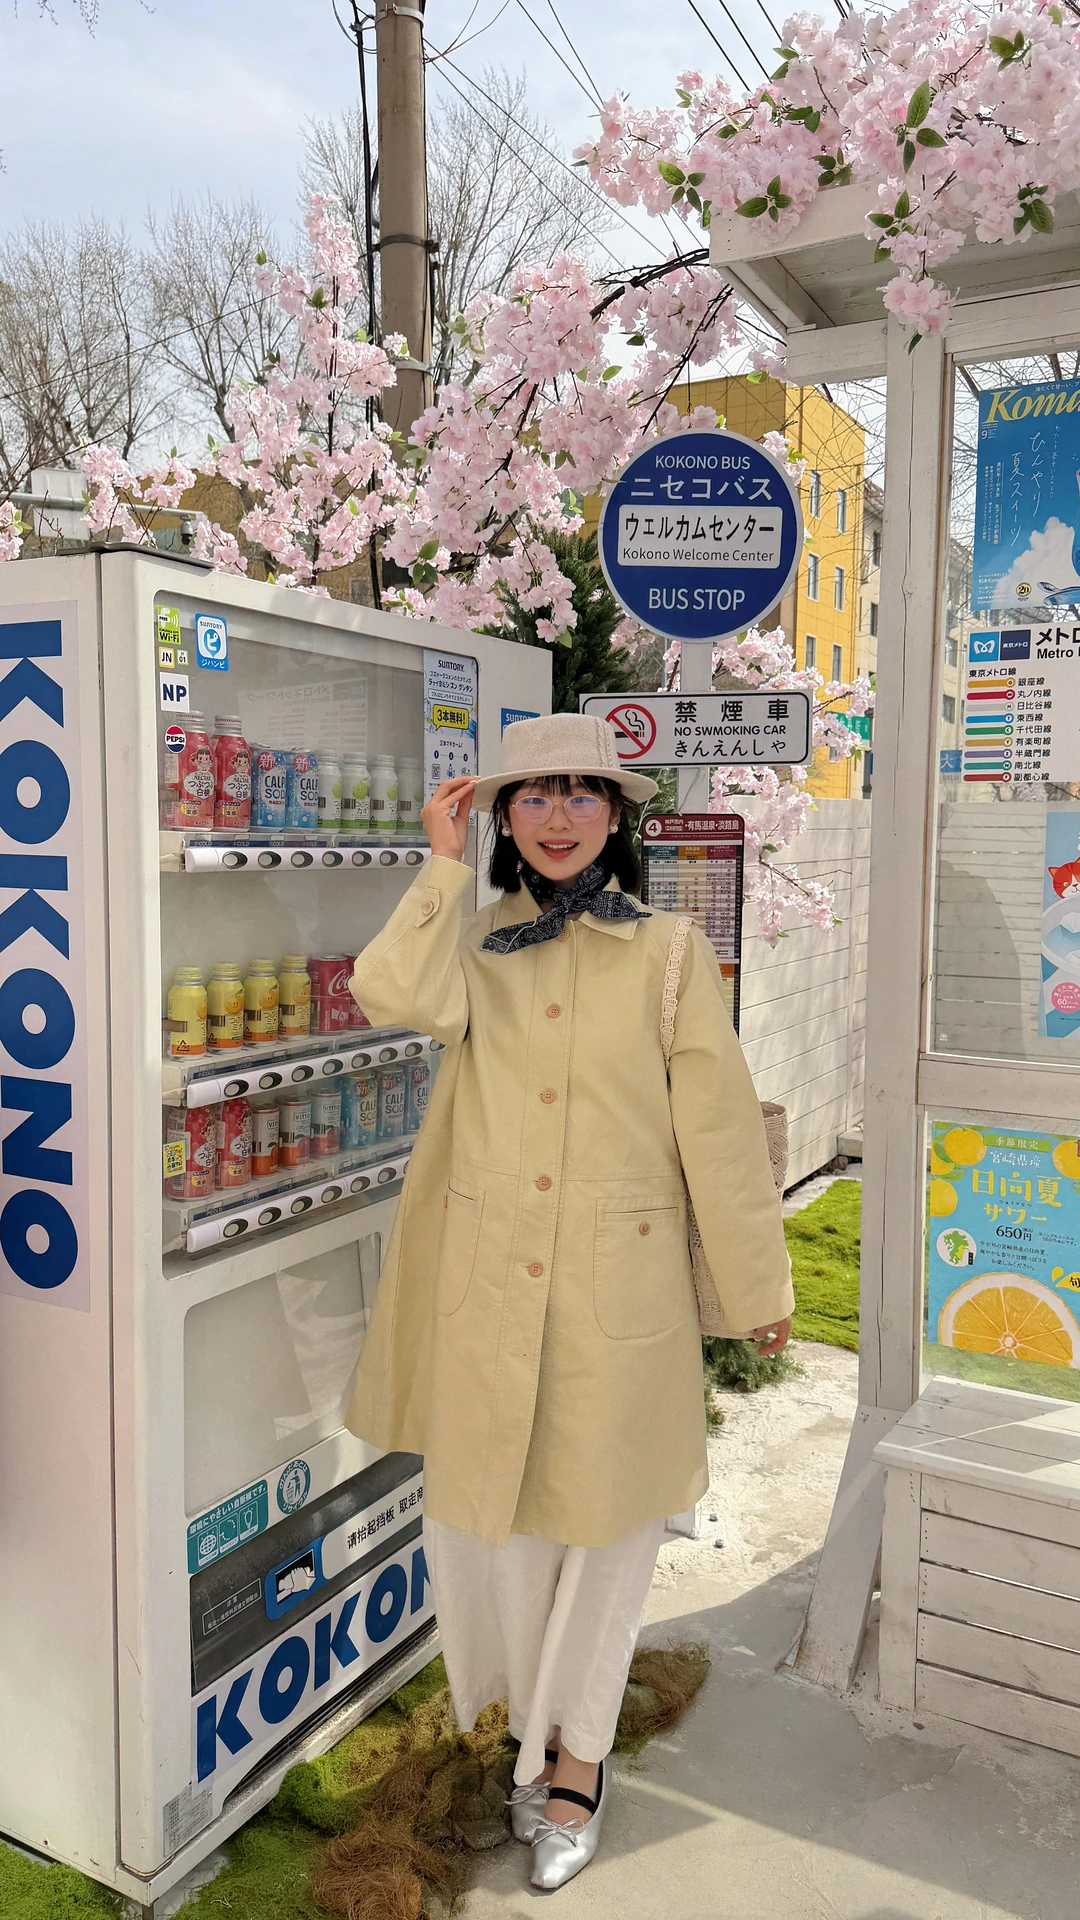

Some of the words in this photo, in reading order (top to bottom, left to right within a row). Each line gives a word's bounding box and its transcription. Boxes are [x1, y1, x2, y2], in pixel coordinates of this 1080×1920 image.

[981, 430, 988, 440] 9
[655, 455, 718, 470] KOKONO
[721, 456, 751, 470] BUS
[1029, 431, 1047, 517] ひんやり
[631, 474, 773, 501] ニセコバス
[1009, 451, 1026, 547] 夏スイーツ
[623, 547, 671, 560] Kokono
[673, 548, 730, 561] Welcome
[732, 549, 774, 562] Center
[648, 587, 689, 610] BUS
[692, 588, 746, 611] STOP
[1002, 640, 1029, 648] 東京メトロ
[161, 652, 172, 663] JN
[1036, 648, 1074, 659] Metro
[438, 659, 465, 672] SUNTORY
[968, 667, 1017, 678] 東京メトロ線
[1017, 677, 1045, 687] 銀座線
[162, 683, 187, 702] NP
[1017, 689, 1052, 699] 丸ノ内線
[675, 698, 789, 723] 禁煙車
[1017, 701, 1052, 711] 日比谷線
[1016, 713, 1044, 722] 東西線
[674, 726, 692, 737] NO
[695, 725, 761, 736] SWMOKING
[763, 724, 787, 735] CAR
[1016, 725, 1052, 734] 千代田線
[166, 735, 185, 743] PEPSI
[1015, 736, 1052, 746] 有楽町線
[1015, 748, 1051, 758] 半蔵門線
[259, 754, 275, 770] 新
[295, 757, 310, 772] 新
[1014, 760, 1042, 770] 南北線
[1013, 772, 1050, 782] 副都心線
[648, 822, 658, 833] 4
[0, 620, 78, 1290] KOKONO
[995, 1136, 1039, 1150] 季節限定
[990, 1150, 1042, 1168] 宮崎県産
[972, 1168, 1062, 1208] 日向夏
[983, 1202, 1048, 1225] サワー
[995, 1225, 1033, 1242] 650円
[347, 1505, 395, 1550] 请抬起挡板
